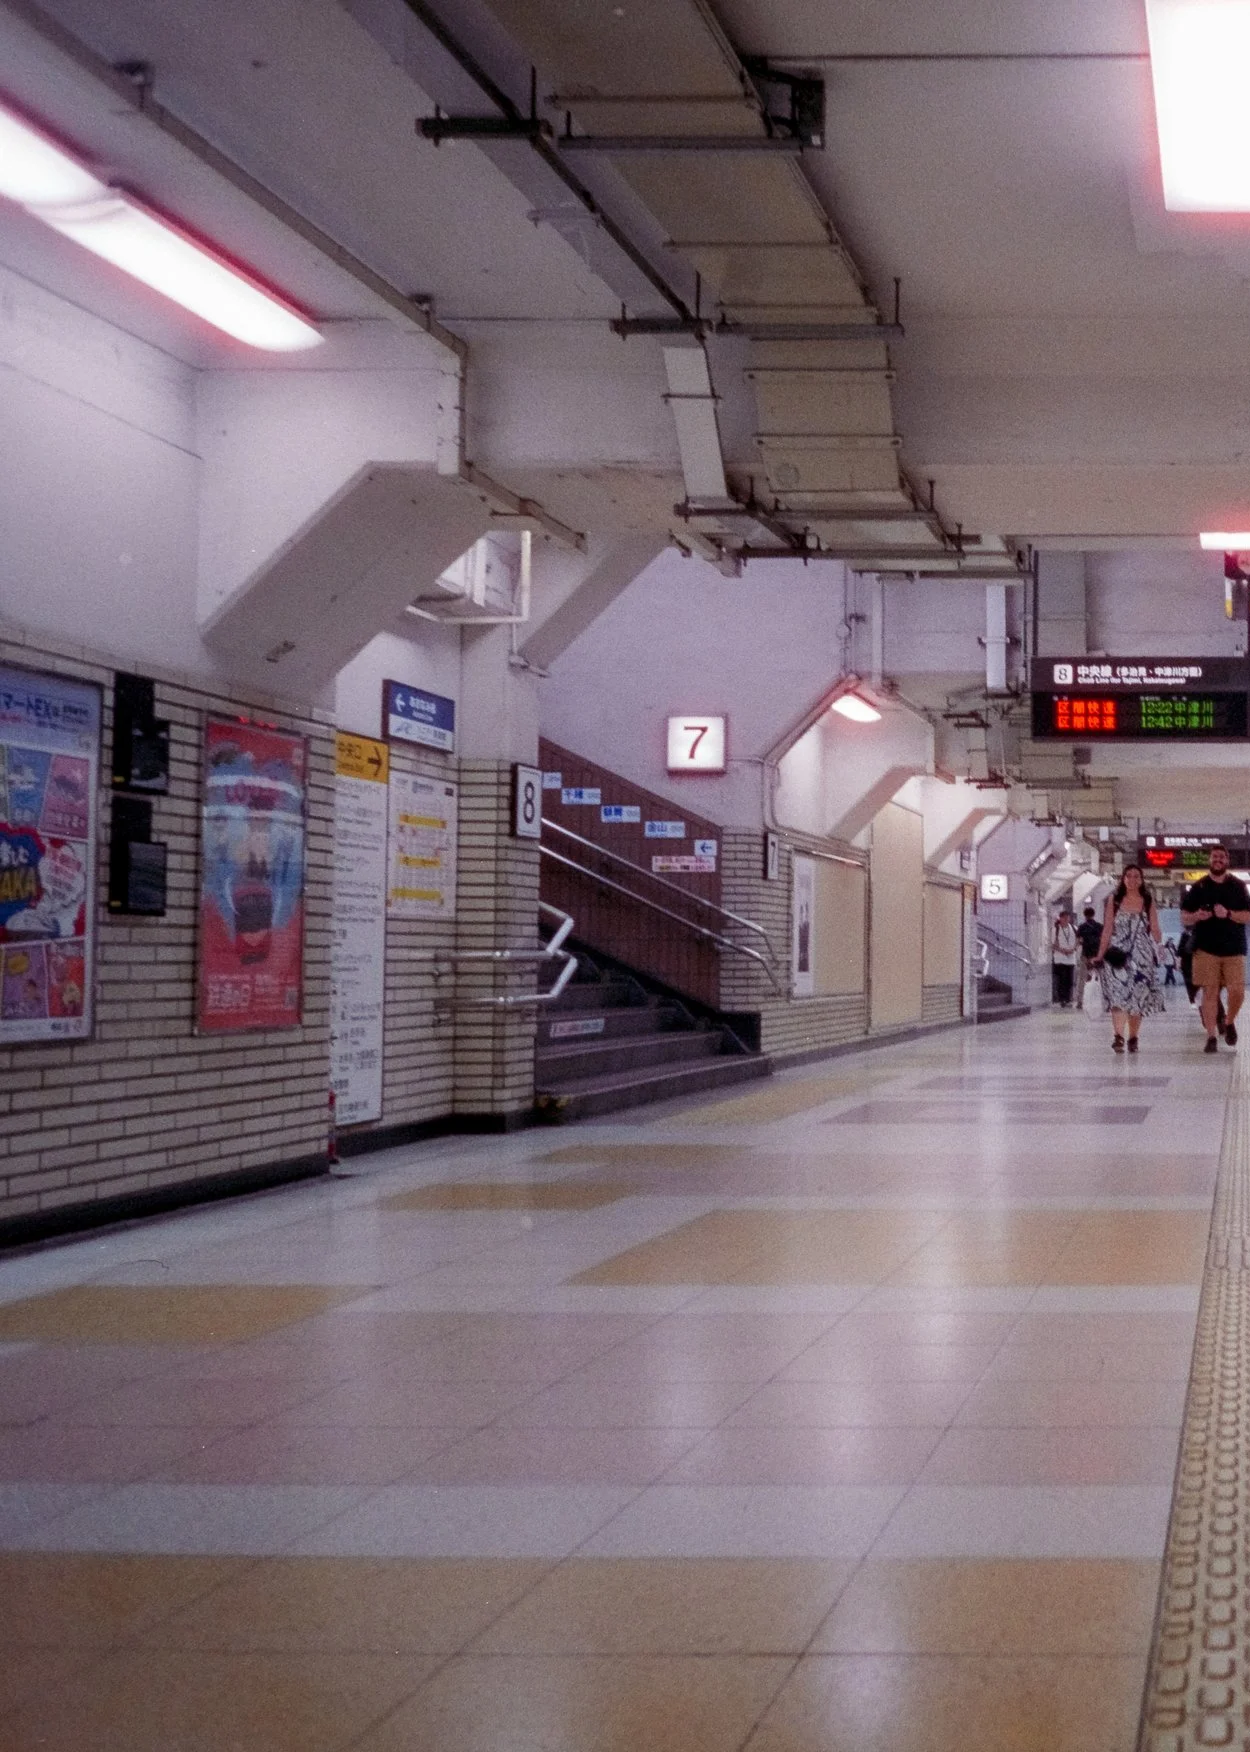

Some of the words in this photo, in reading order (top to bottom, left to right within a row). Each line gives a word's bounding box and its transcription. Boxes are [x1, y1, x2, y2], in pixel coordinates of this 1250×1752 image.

[1057, 701, 1116, 715] 区間快速
[1141, 701, 1173, 715] 12:22
[1174, 701, 1214, 715] 中津川
[1057, 715, 1116, 729] 区間快速
[1141, 715, 1173, 729] 12:42
[1174, 715, 1214, 729] 中津川
[683, 725, 709, 760] 7
[523, 780, 535, 825] 8
[988, 879, 1001, 895] 5
